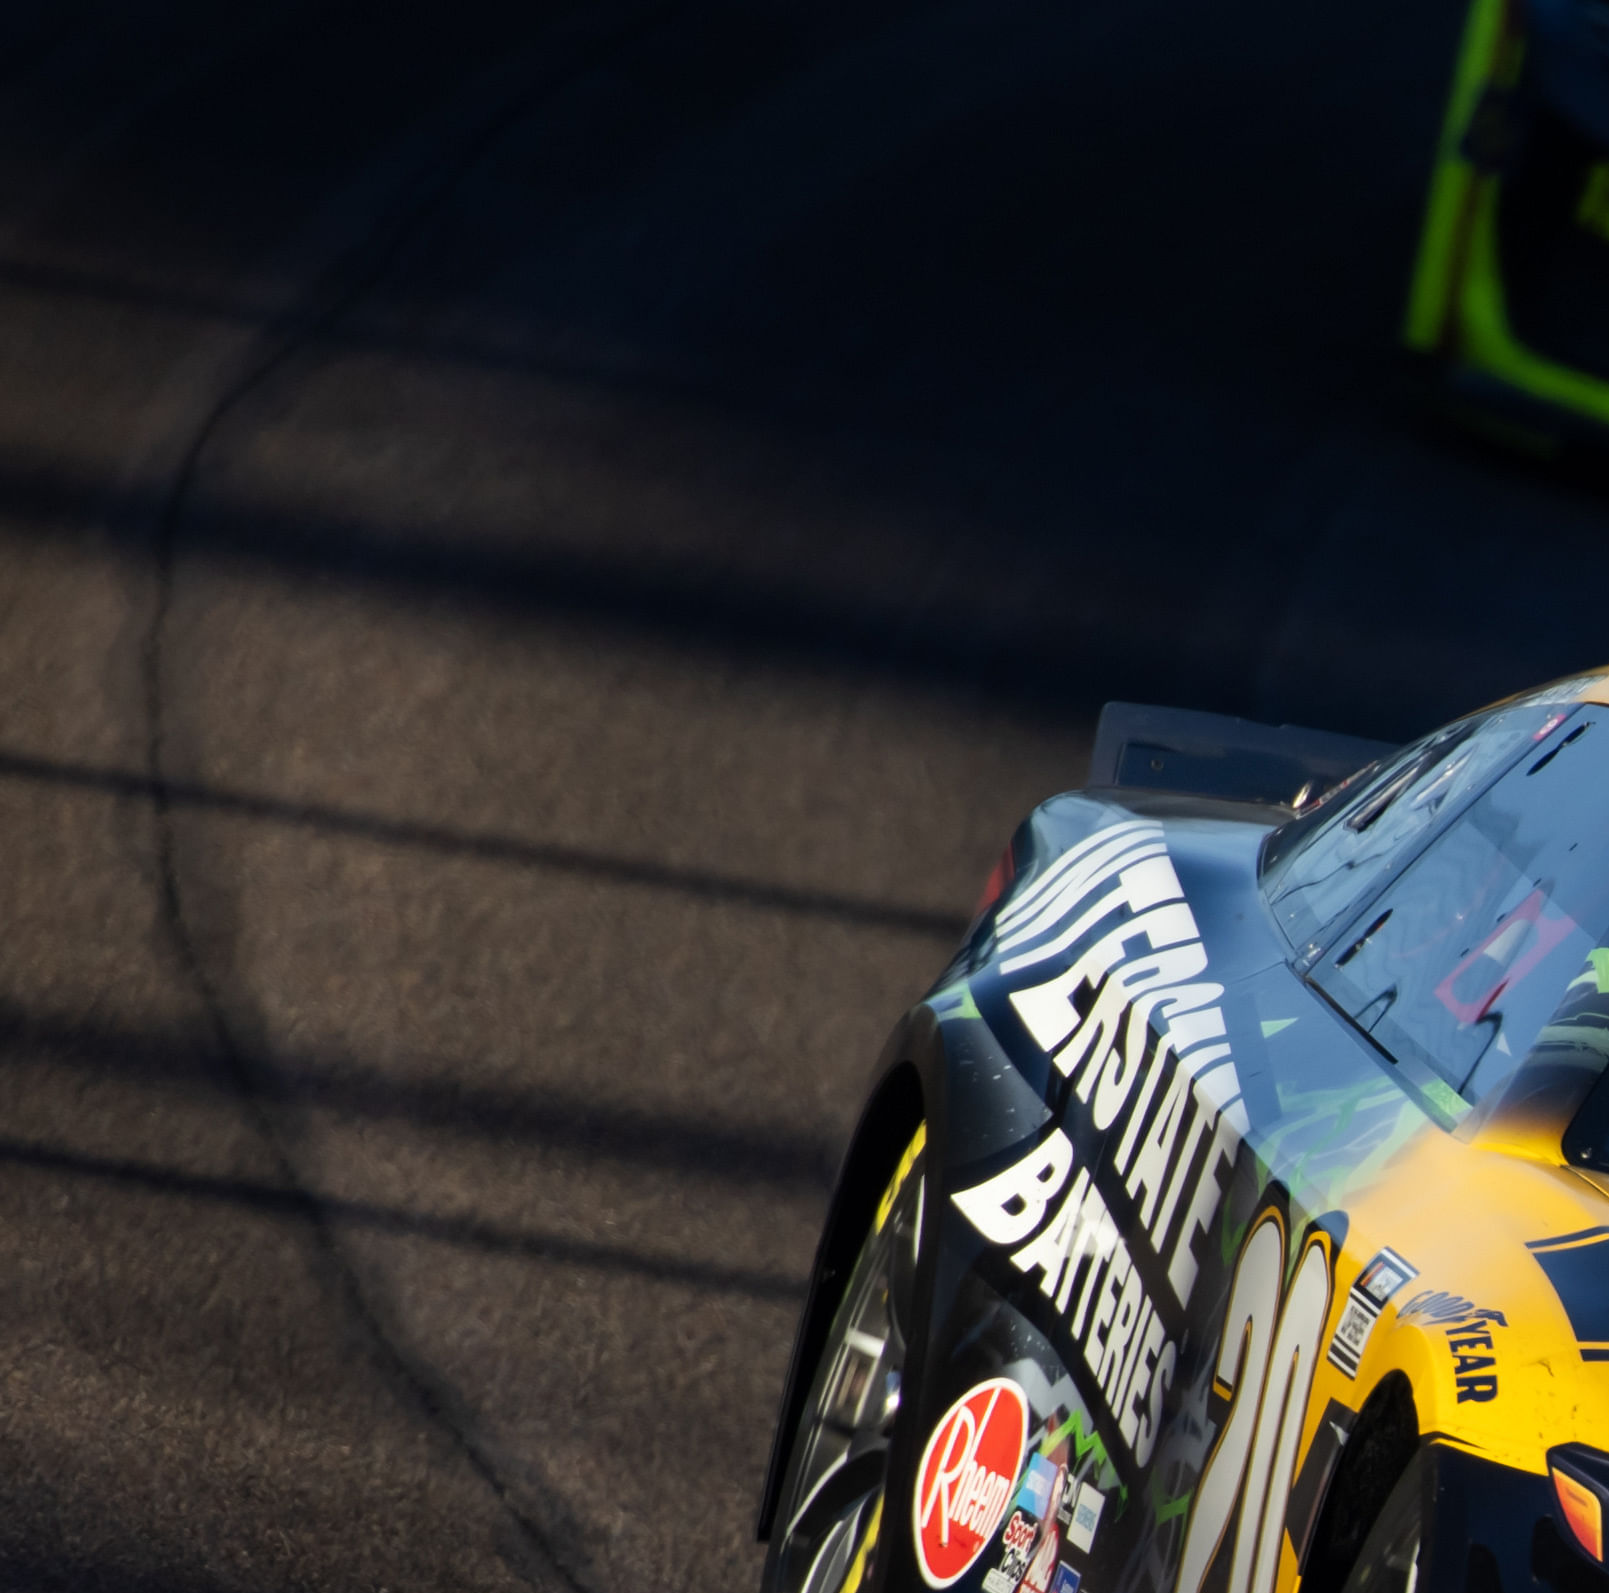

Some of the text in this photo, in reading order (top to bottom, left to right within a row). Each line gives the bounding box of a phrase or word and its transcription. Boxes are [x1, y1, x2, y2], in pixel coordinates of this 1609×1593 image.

[994, 819, 1250, 1311] INTERSTATE
[921, 1386, 1011, 1548] Rheem
[951, 1127, 1178, 1469] BATTERIES
